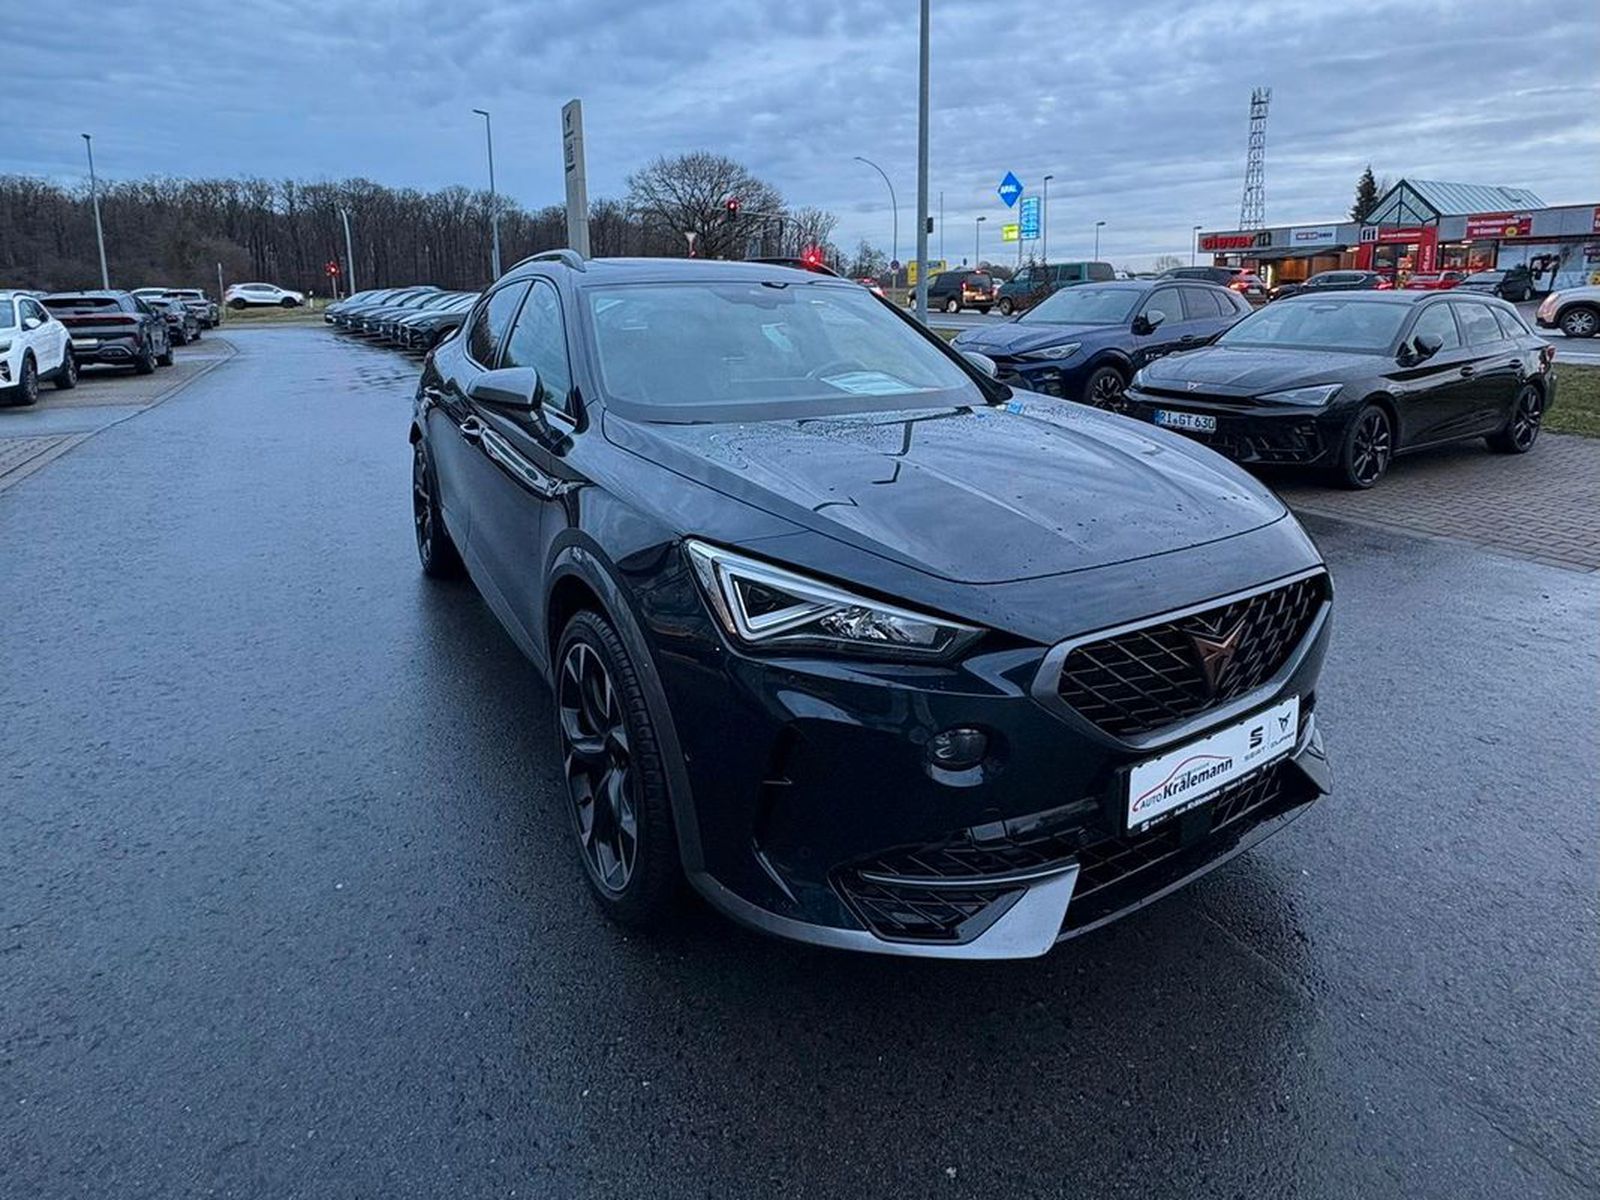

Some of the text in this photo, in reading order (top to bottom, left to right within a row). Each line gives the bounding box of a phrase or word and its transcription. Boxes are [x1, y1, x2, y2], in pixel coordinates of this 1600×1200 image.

[1179, 414, 1193, 426] GT
[1194, 416, 1215, 430] 630
[1140, 792, 1163, 809] AUTO
